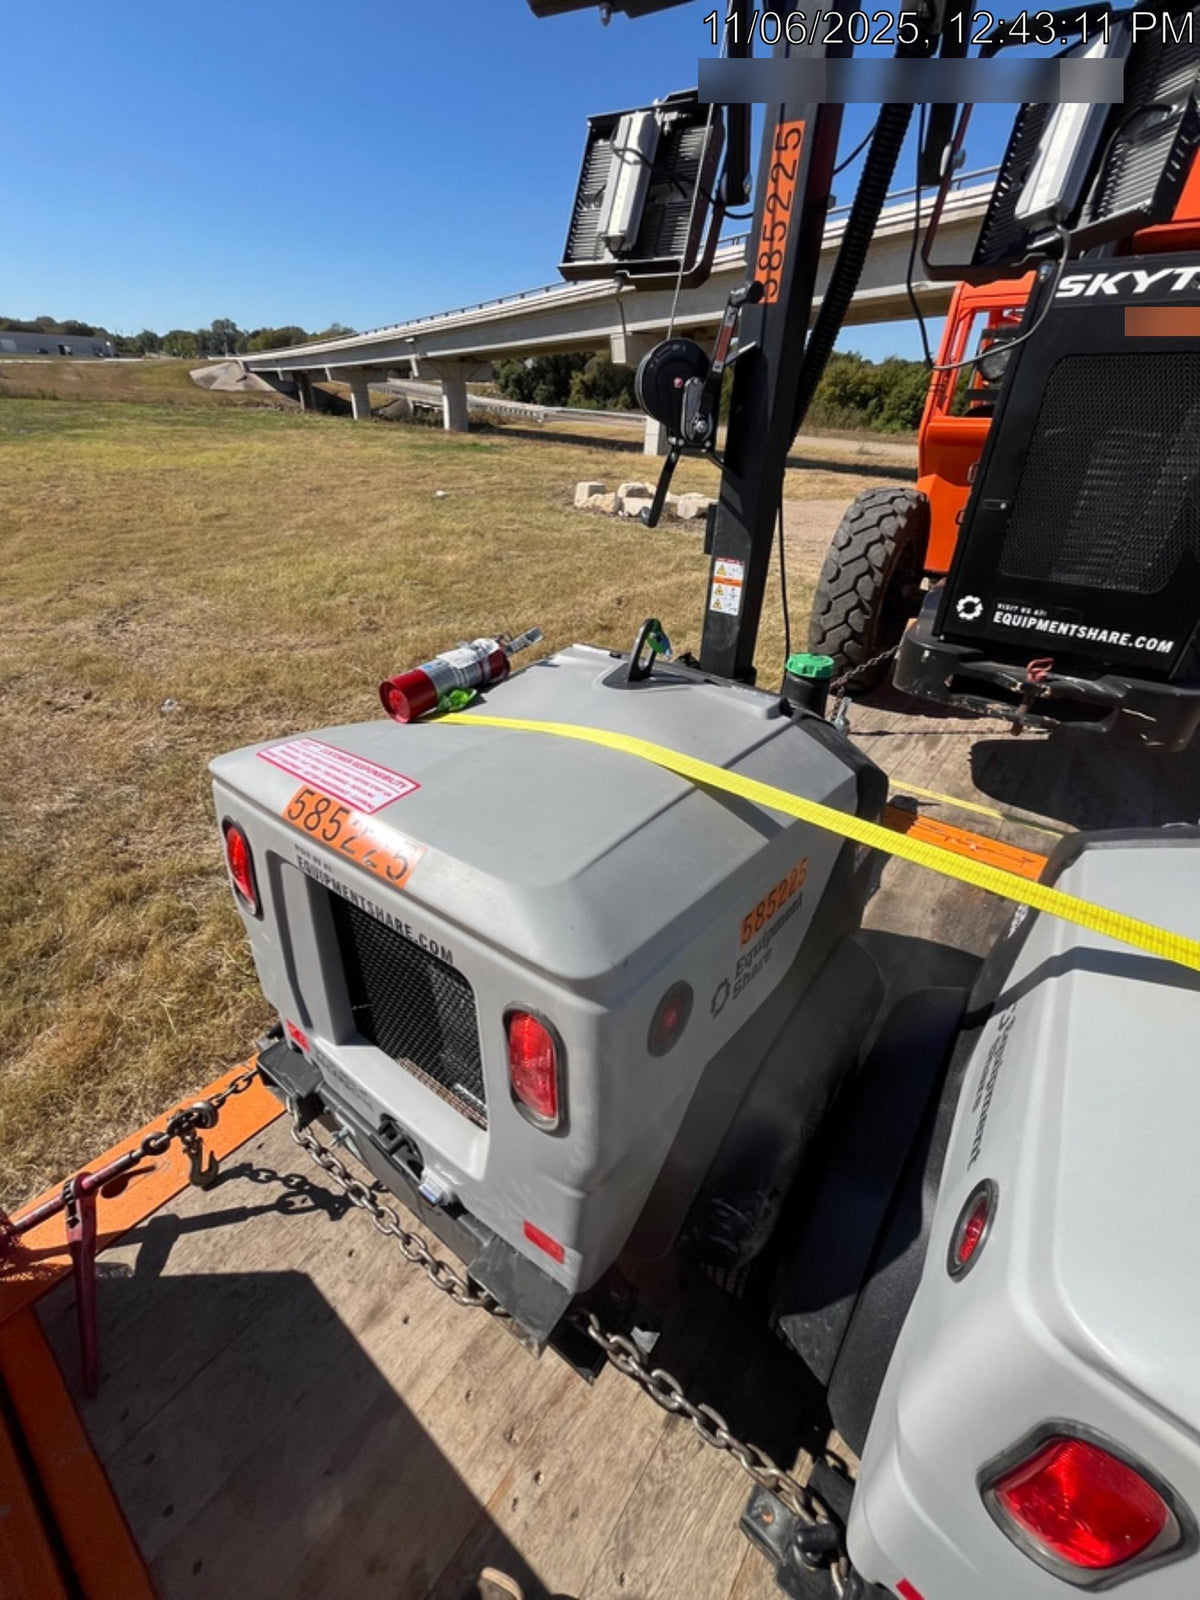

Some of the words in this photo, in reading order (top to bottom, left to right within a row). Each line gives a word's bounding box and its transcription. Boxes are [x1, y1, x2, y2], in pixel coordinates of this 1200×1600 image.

[1055, 266, 1200, 298] SKYT
[993, 611, 1174, 654] EQUIPMENTSHARE.COM
[296, 855, 454, 965] EQUIPMENTSHARE.COM
